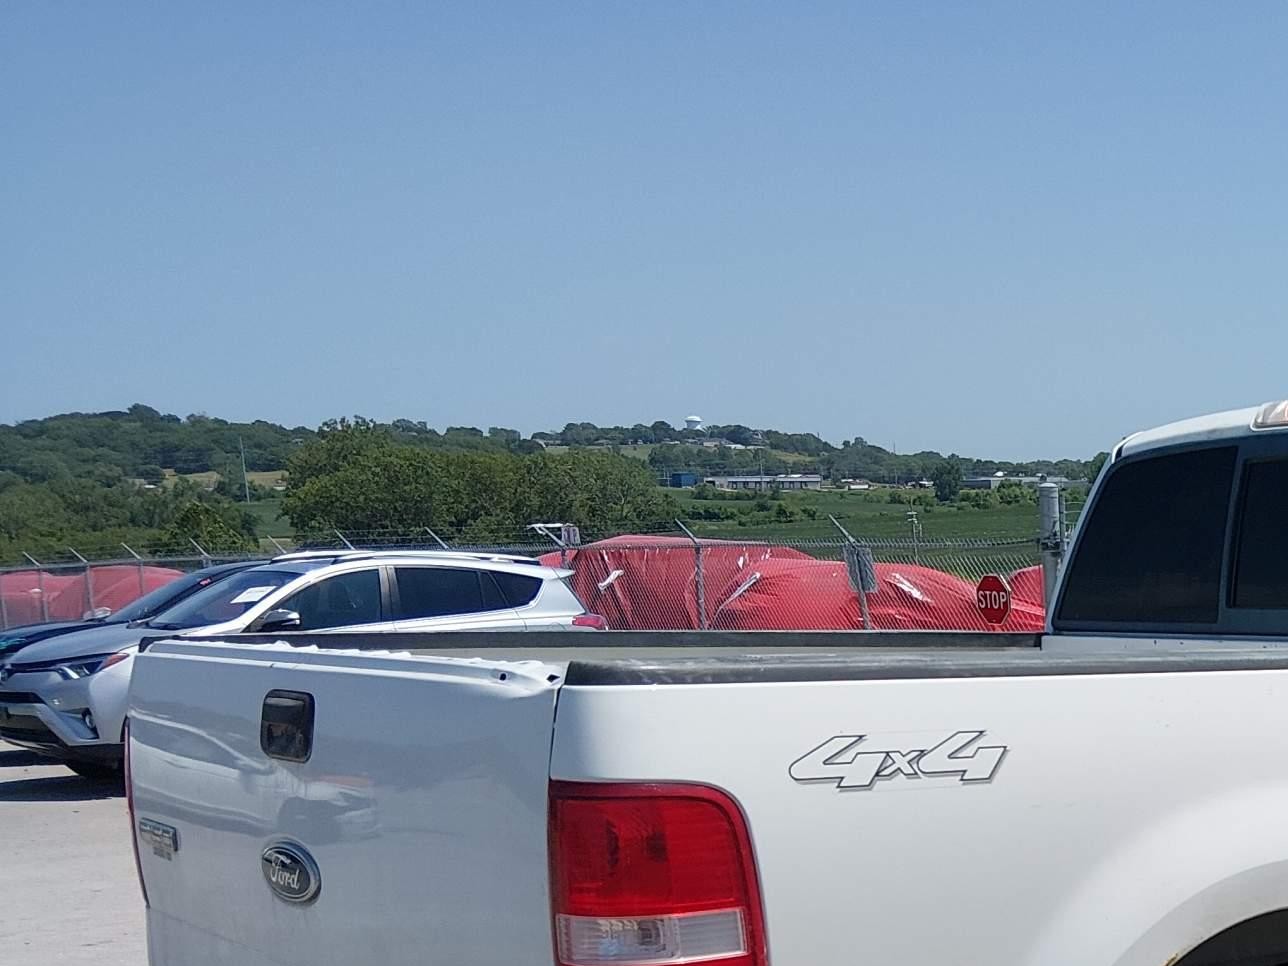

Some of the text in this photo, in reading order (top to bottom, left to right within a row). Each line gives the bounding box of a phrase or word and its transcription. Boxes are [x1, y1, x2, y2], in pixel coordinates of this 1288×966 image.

[978, 591, 1006, 609] STOP
[789, 730, 1008, 790] 4x4
[271, 853, 300, 889] Ford
